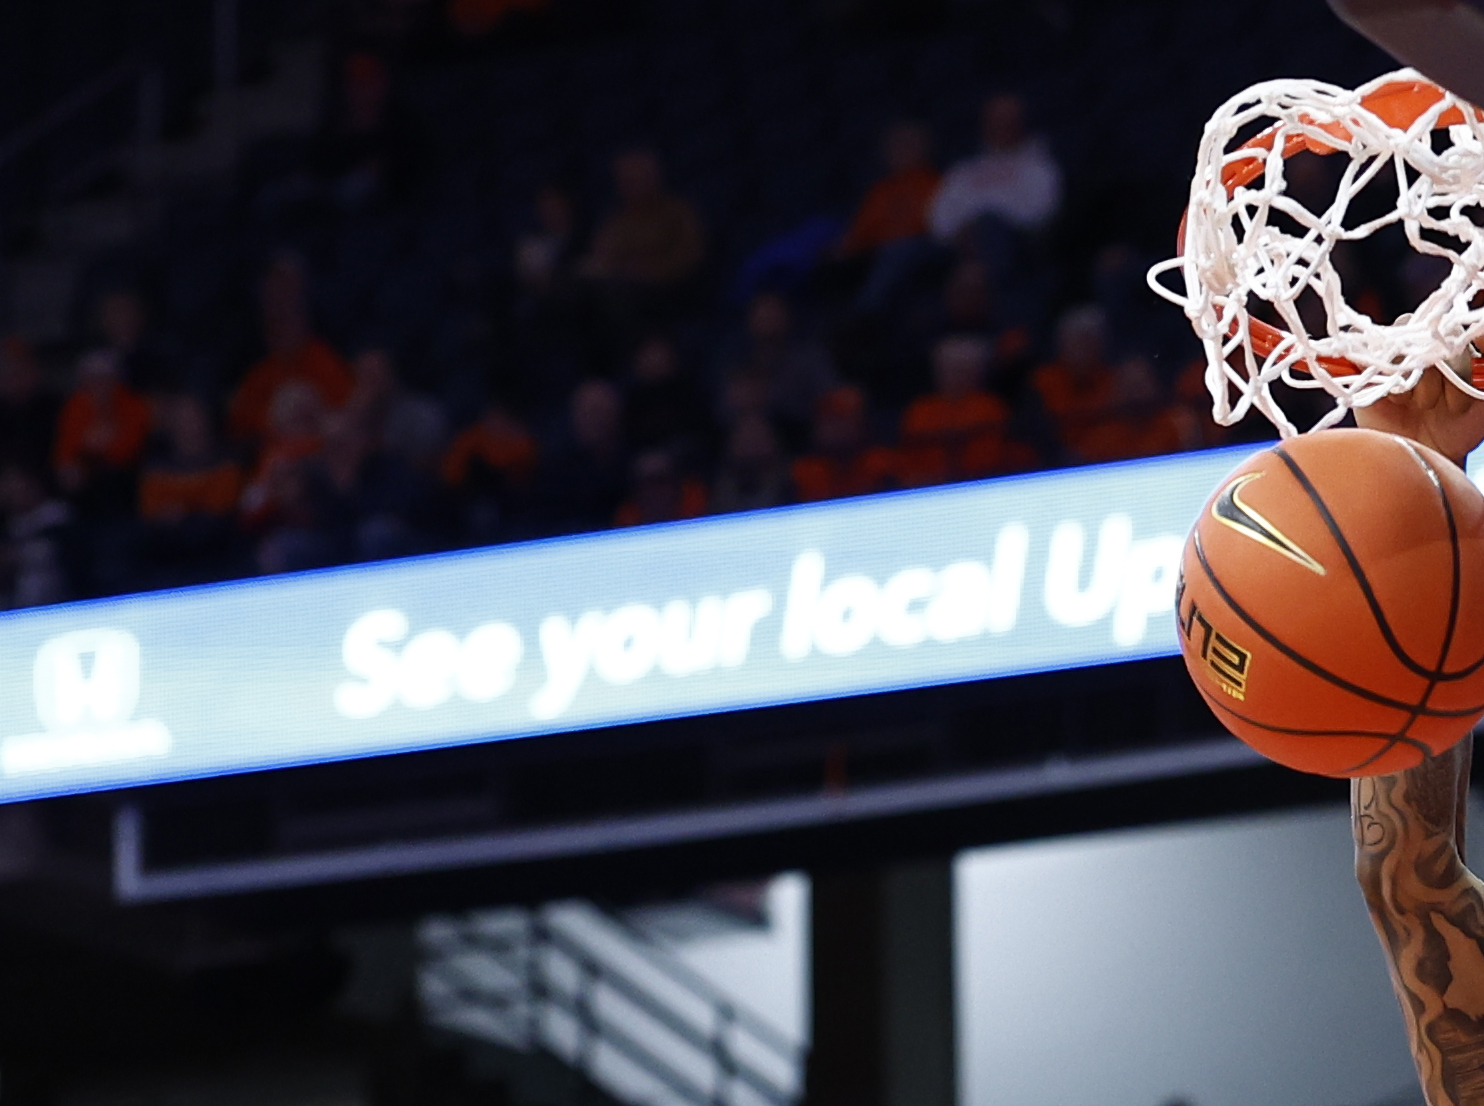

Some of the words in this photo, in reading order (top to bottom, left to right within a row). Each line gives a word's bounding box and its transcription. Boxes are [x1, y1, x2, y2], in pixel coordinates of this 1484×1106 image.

[333, 607, 523, 720] See
[529, 587, 773, 721] your
[781, 519, 1028, 662] local
